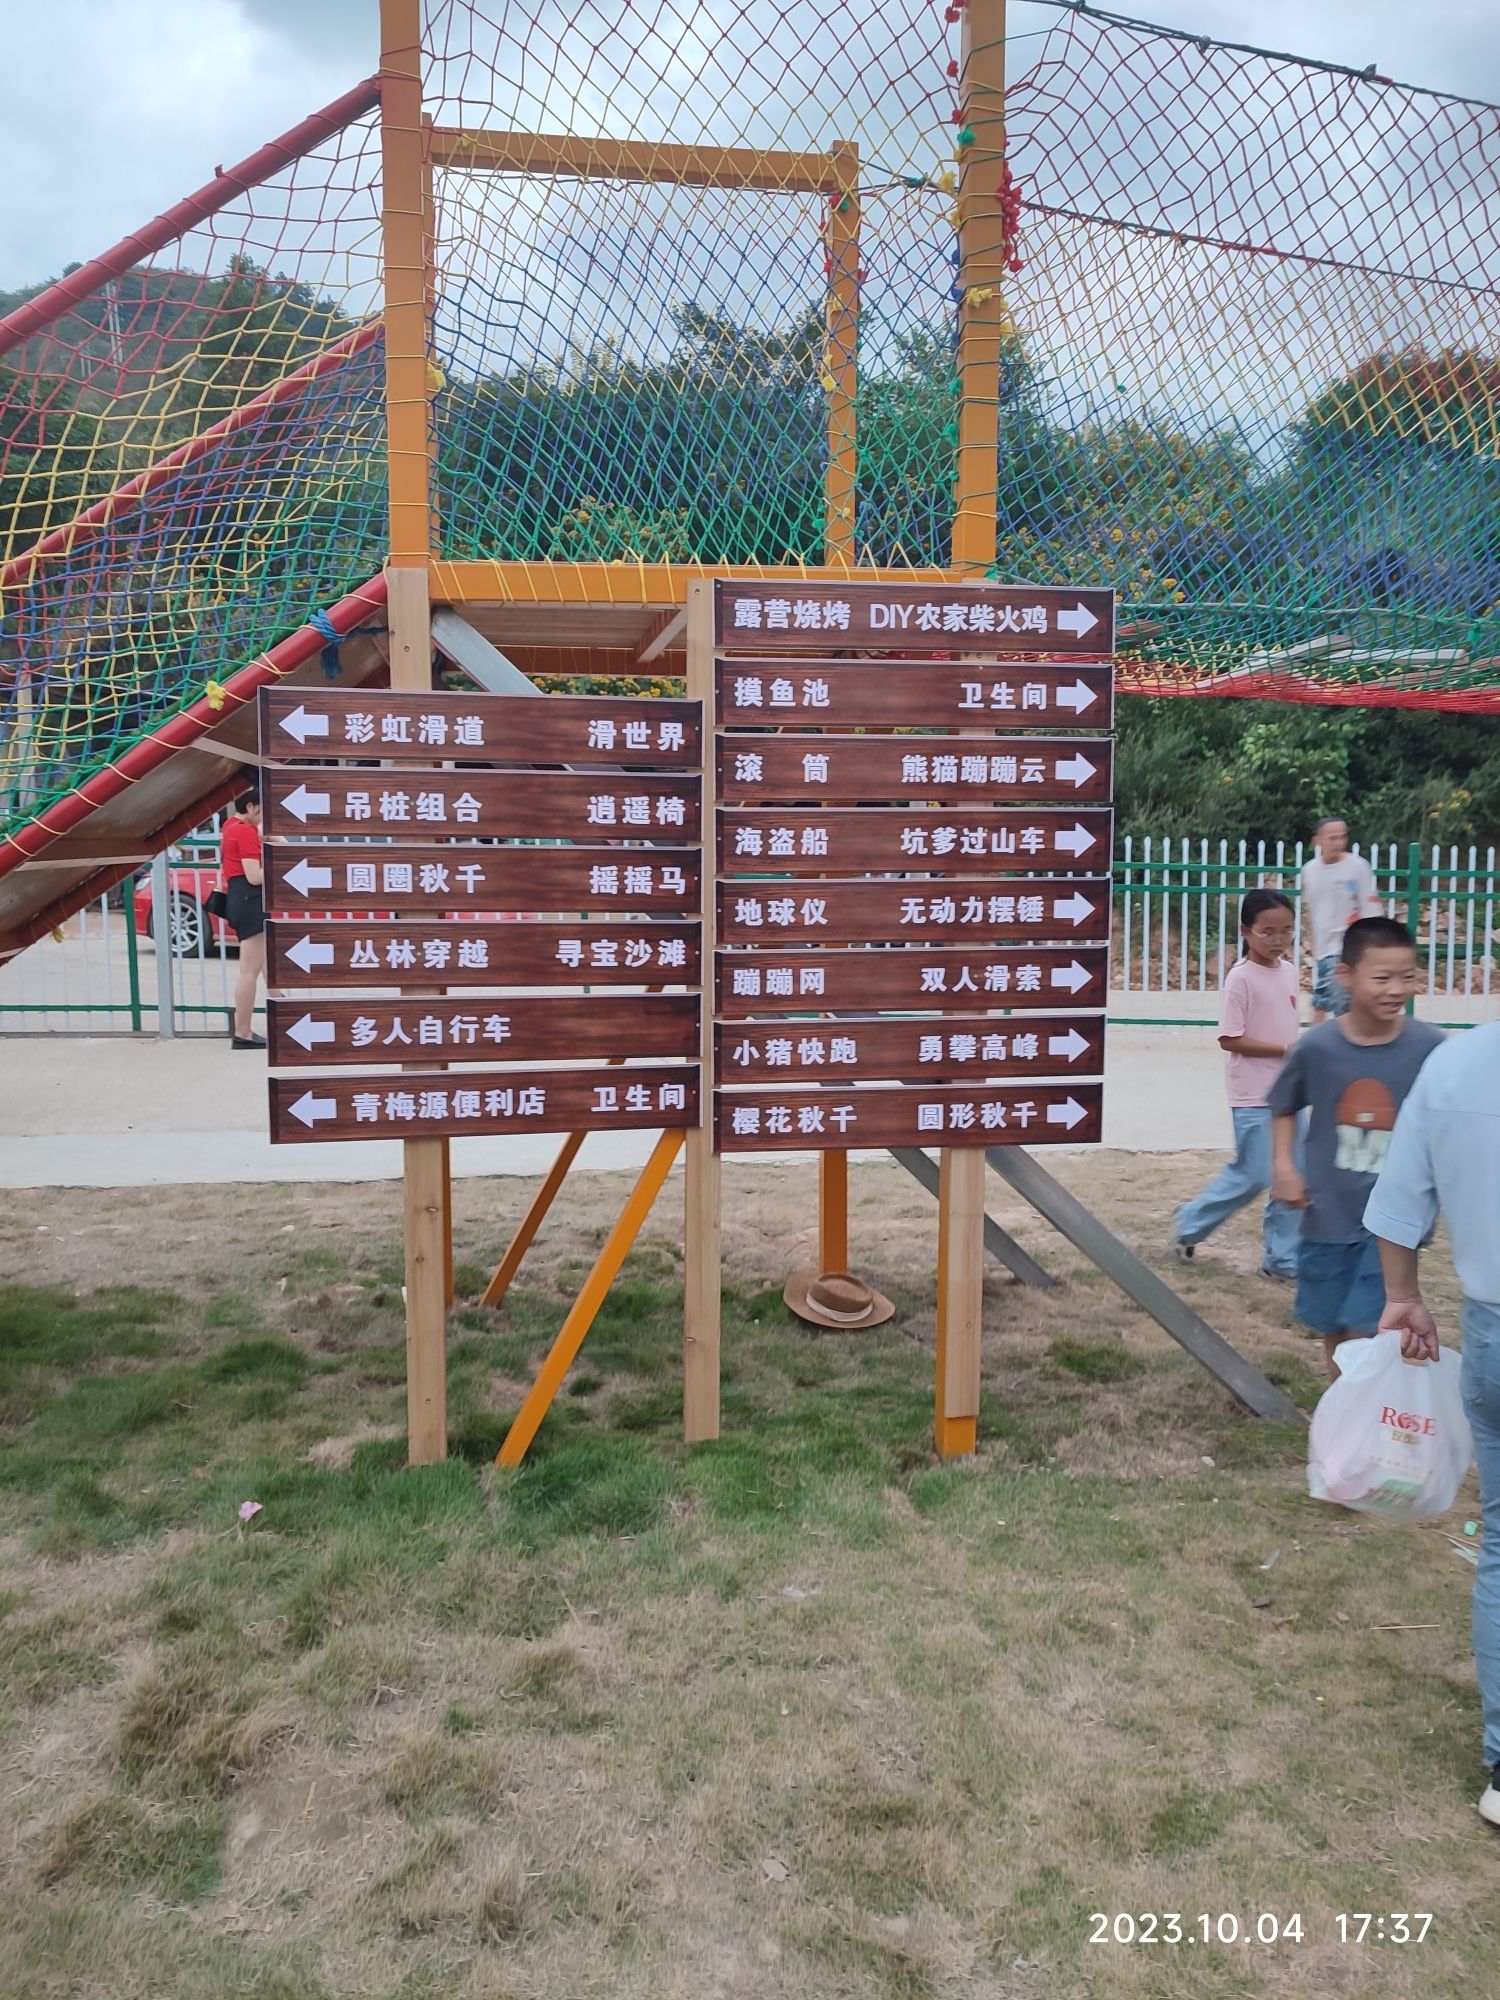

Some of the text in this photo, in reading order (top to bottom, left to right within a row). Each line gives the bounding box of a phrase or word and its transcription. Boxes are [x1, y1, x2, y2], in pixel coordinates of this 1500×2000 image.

[733, 598, 1048, 634] 露营烧烤 DIY农家柴火鸡
[734, 677, 1047, 710] 摸鱼池 卫生间
[344, 712, 686, 752] 彩虹滑道 滑世界
[900, 754, 1046, 784] 熊猫蹦蹦云
[345, 790, 686, 826] 吊桩组合 逍遥椅
[734, 826, 1046, 856] 海盗船 坑爹过山车
[346, 863, 686, 895] 圆圈秋千 摇摇马
[734, 895, 1045, 927] 地球仪 无动力摆锤
[349, 938, 686, 969] 丛林穿越 寻宝沙滩
[732, 964, 1042, 996] 蹦蹦网 双人滑索
[350, 1014, 512, 1047] 多人自行车
[732, 1033, 1039, 1066] 小猪快跑 勇攀高峰
[351, 1083, 685, 1122] 青梅源便利店 卫生间
[731, 1101, 1038, 1135] 樱花秋千 圆形秋千
